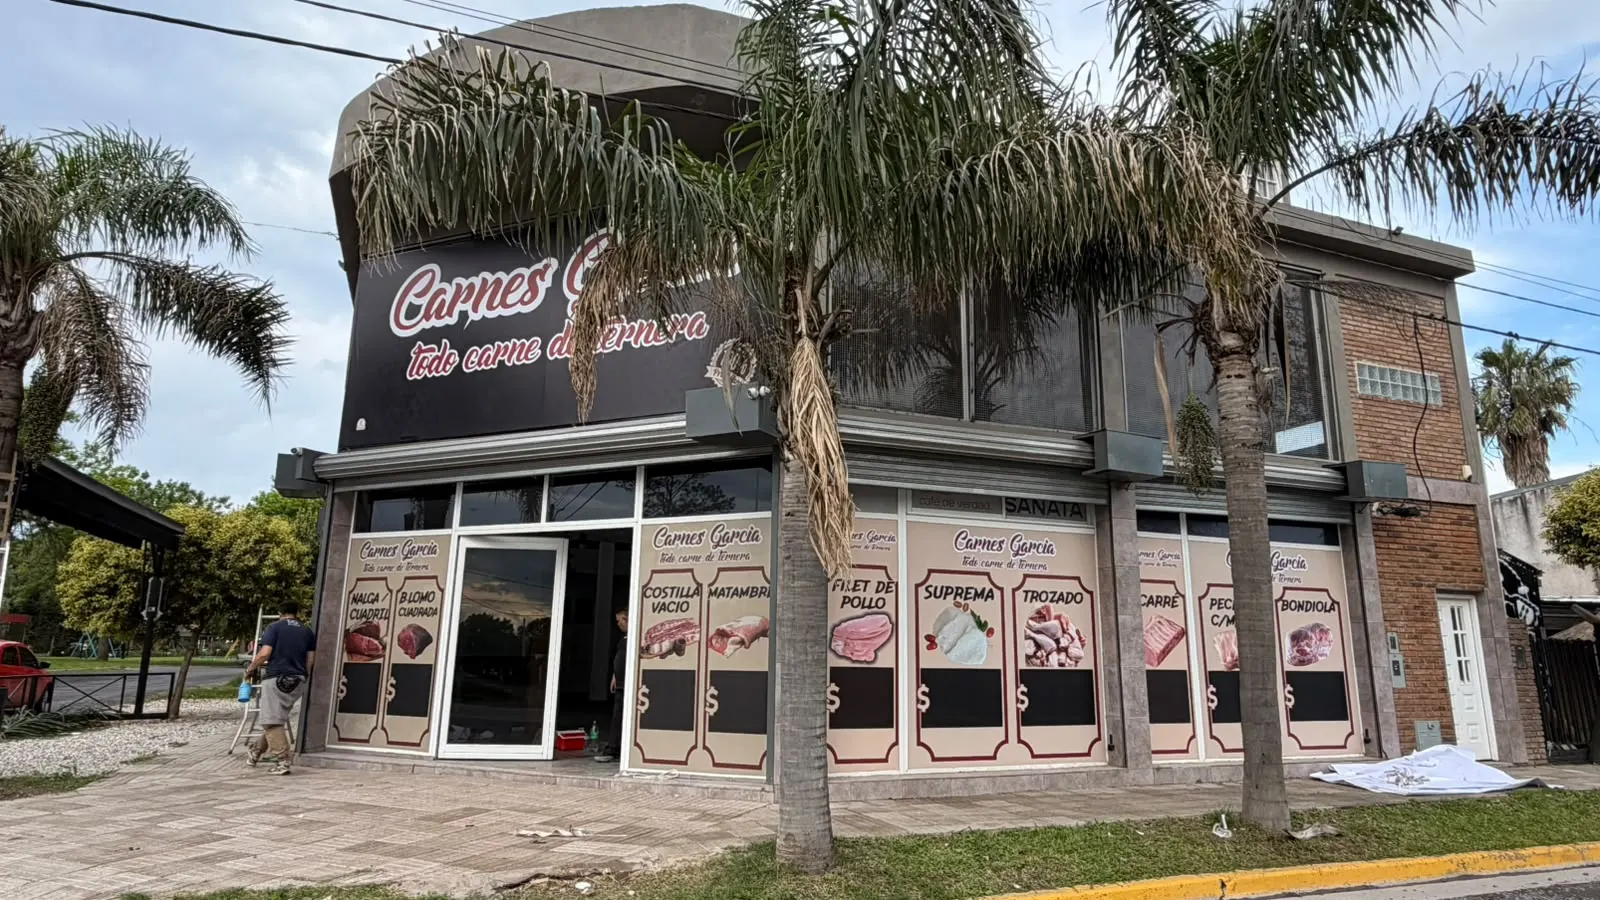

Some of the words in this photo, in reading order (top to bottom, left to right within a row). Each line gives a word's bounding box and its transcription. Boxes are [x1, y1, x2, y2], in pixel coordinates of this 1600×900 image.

[391, 258, 558, 336] Carnes
[462, 337, 541, 373] carne
[548, 319, 574, 360] d
[1005, 497, 1083, 518] SANATA
[653, 526, 706, 548] Carnes
[954, 530, 1005, 552] Carnes
[360, 541, 398, 559] Carnes
[678, 554, 702, 563] carne
[705, 552, 715, 561] de
[981, 559, 1003, 568] carne
[1006, 558, 1015, 568] de
[643, 586, 700, 599] COSTILLA
[875, 581, 895, 594] DE
[924, 584, 995, 602] SUPREMA
[1022, 590, 1084, 604] TROZADO
[350, 592, 379, 605] NALGA
[651, 601, 690, 613] VACIO
[840, 595, 886, 609] POLLO
[1209, 598, 1234, 610] PEC
[1281, 600, 1336, 613] BONDIOLA
[350, 608, 390, 620] CUADRIL
[398, 607, 438, 617] CUADRADA
[337, 675, 348, 700] $
[385, 676, 396, 701] $
[1284, 683, 1295, 709] $
[637, 684, 649, 713] $
[705, 686, 719, 715] $
[826, 683, 840, 713] $
[917, 684, 930, 712] $
[1016, 684, 1029, 711] $
[1207, 684, 1218, 711] $
